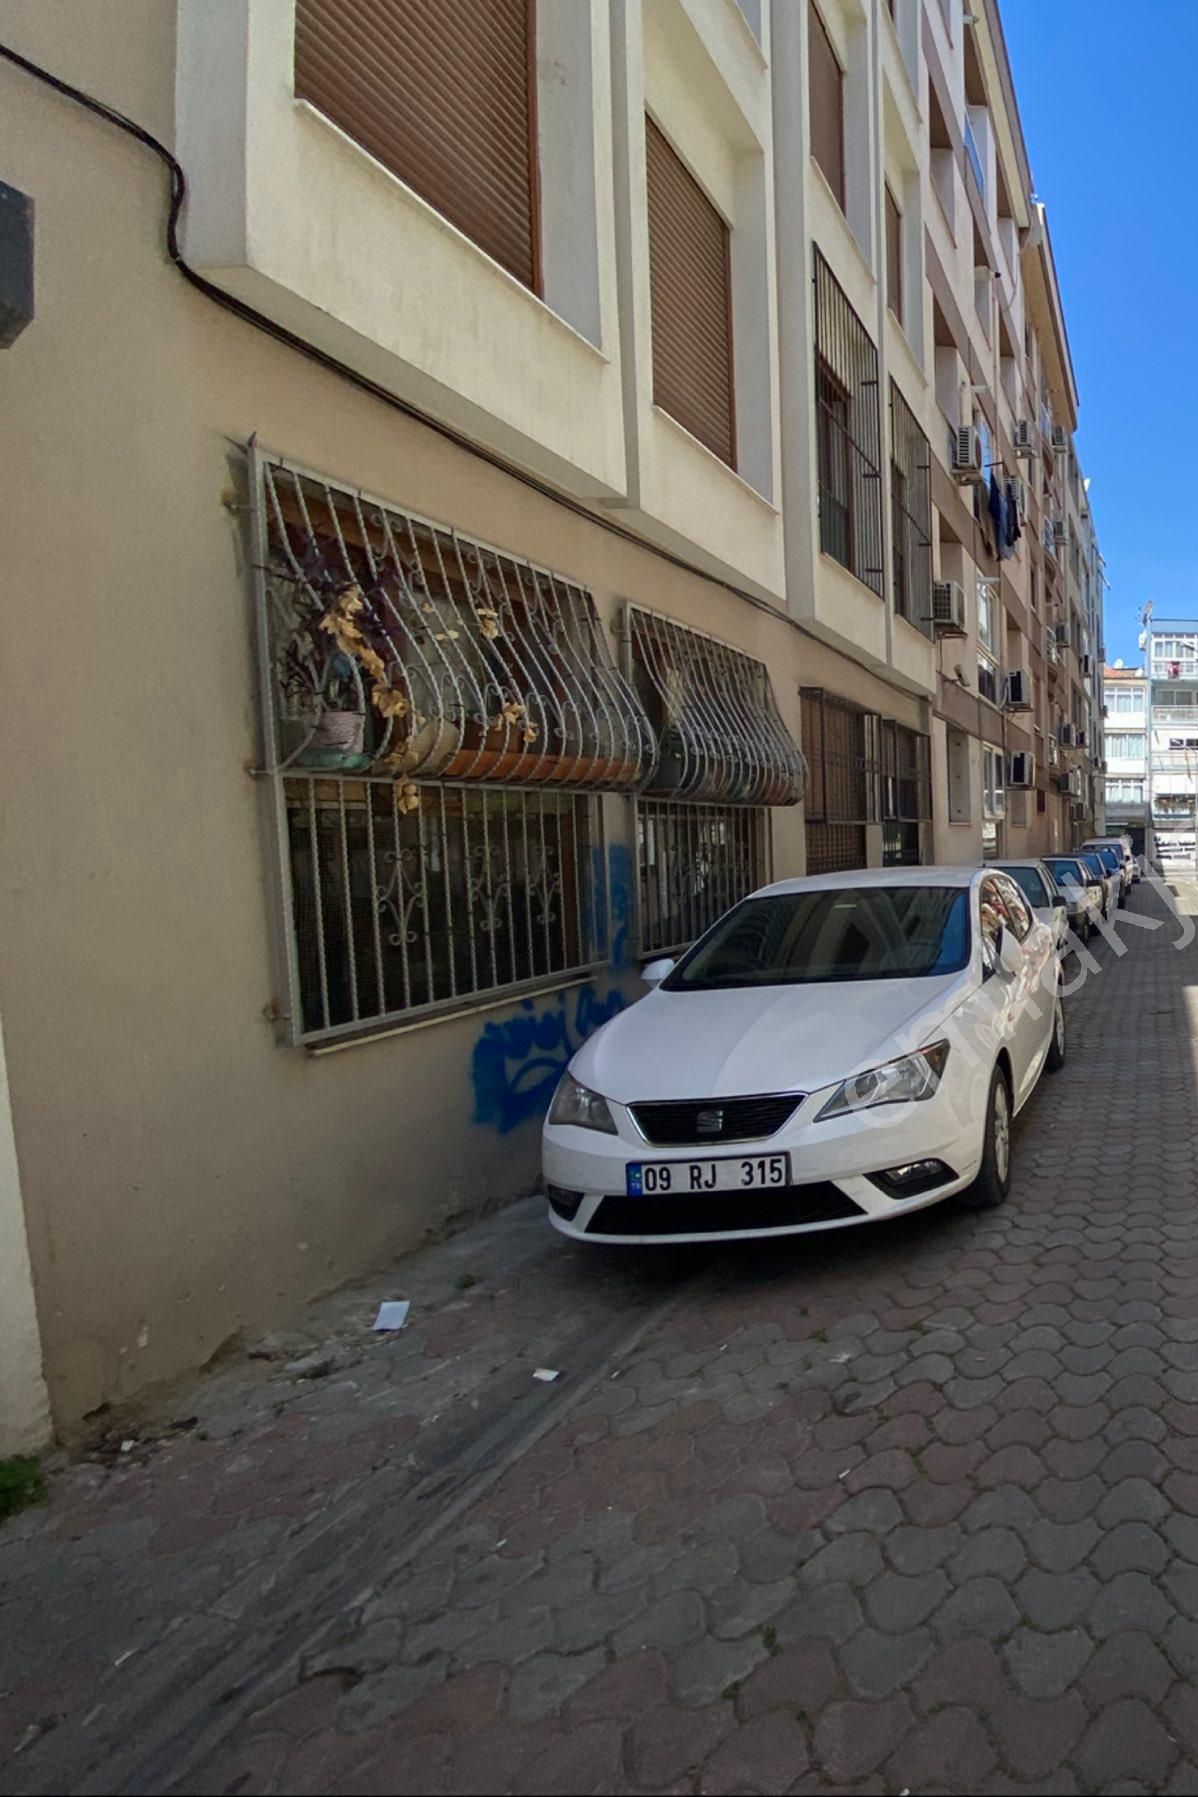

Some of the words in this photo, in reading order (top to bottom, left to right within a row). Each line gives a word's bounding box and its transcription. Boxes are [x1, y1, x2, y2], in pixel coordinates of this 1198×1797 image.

[644, 1167, 671, 1191] 09
[689, 1164, 717, 1190] RJ
[741, 1158, 783, 1186] 315
